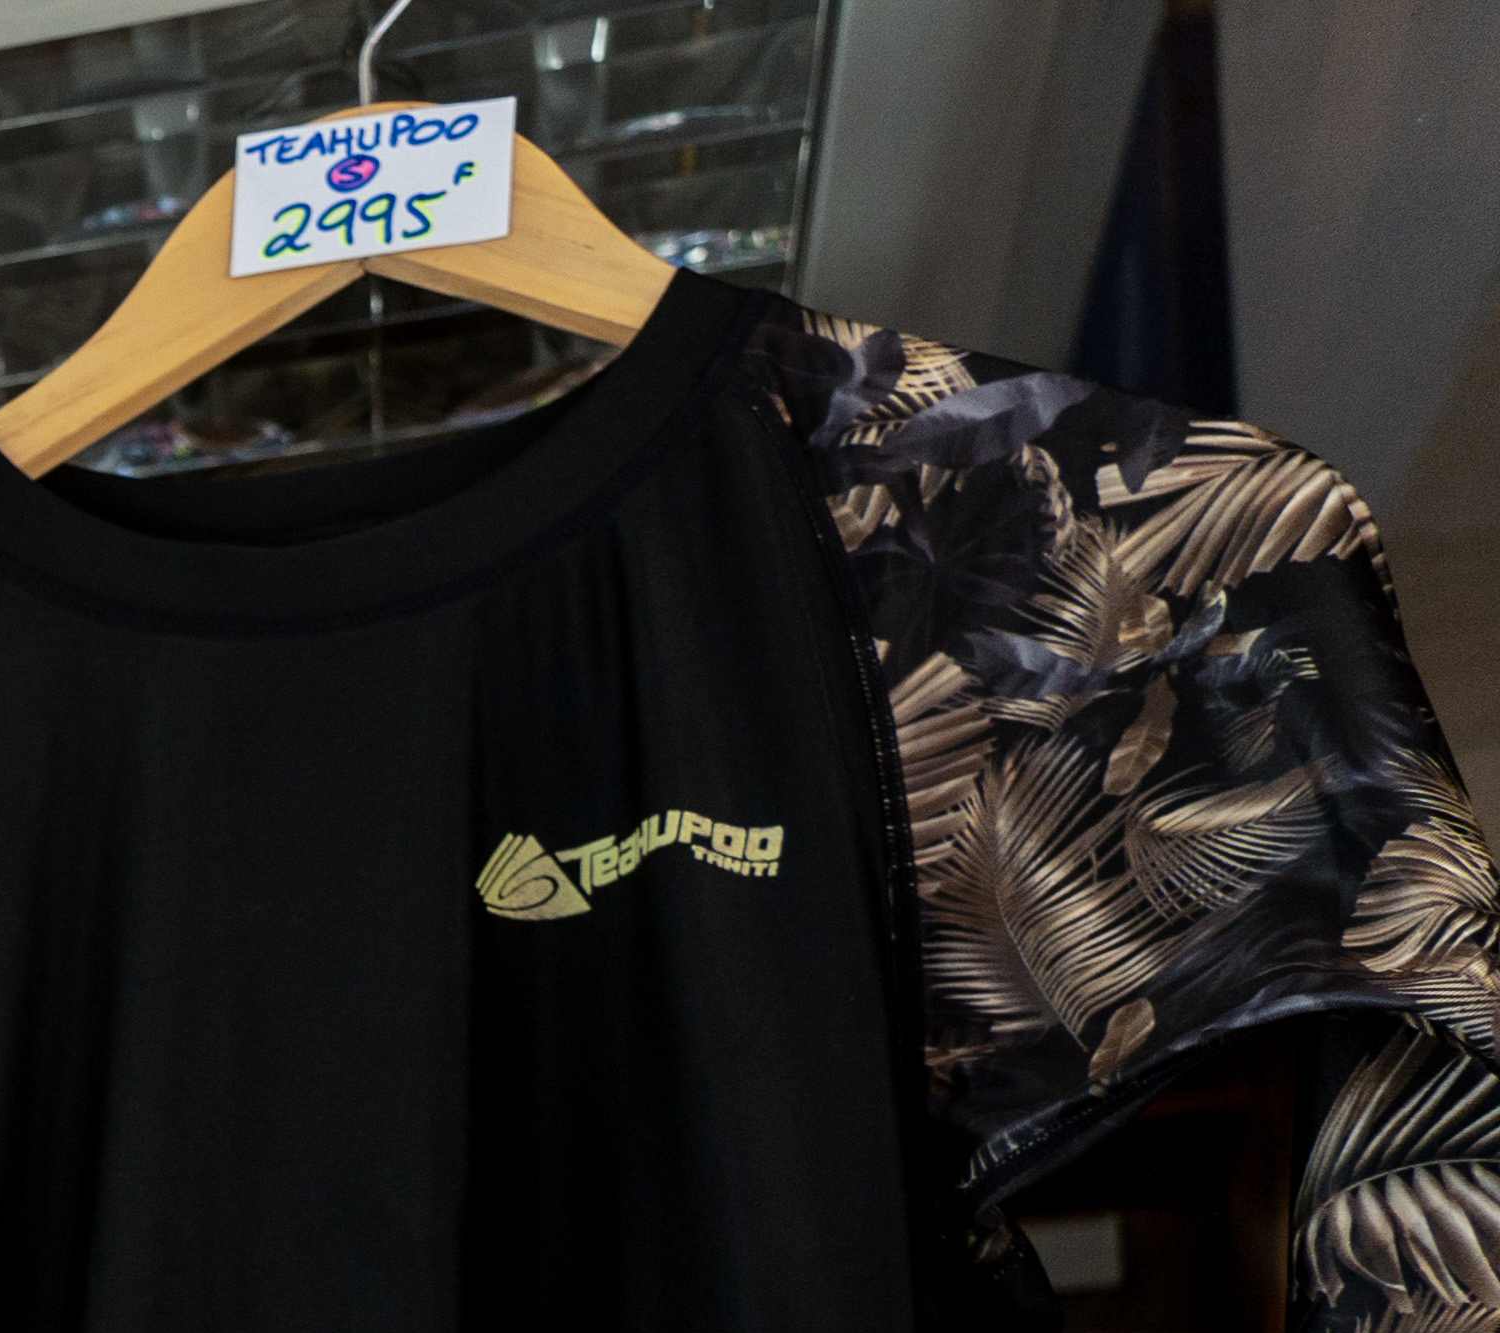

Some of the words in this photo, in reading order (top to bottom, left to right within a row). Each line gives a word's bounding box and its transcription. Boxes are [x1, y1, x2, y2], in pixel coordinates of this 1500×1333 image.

[245, 113, 479, 165] TEAHUPOO
[262, 189, 448, 258] 2995
[690, 843, 779, 878] TAHITI
